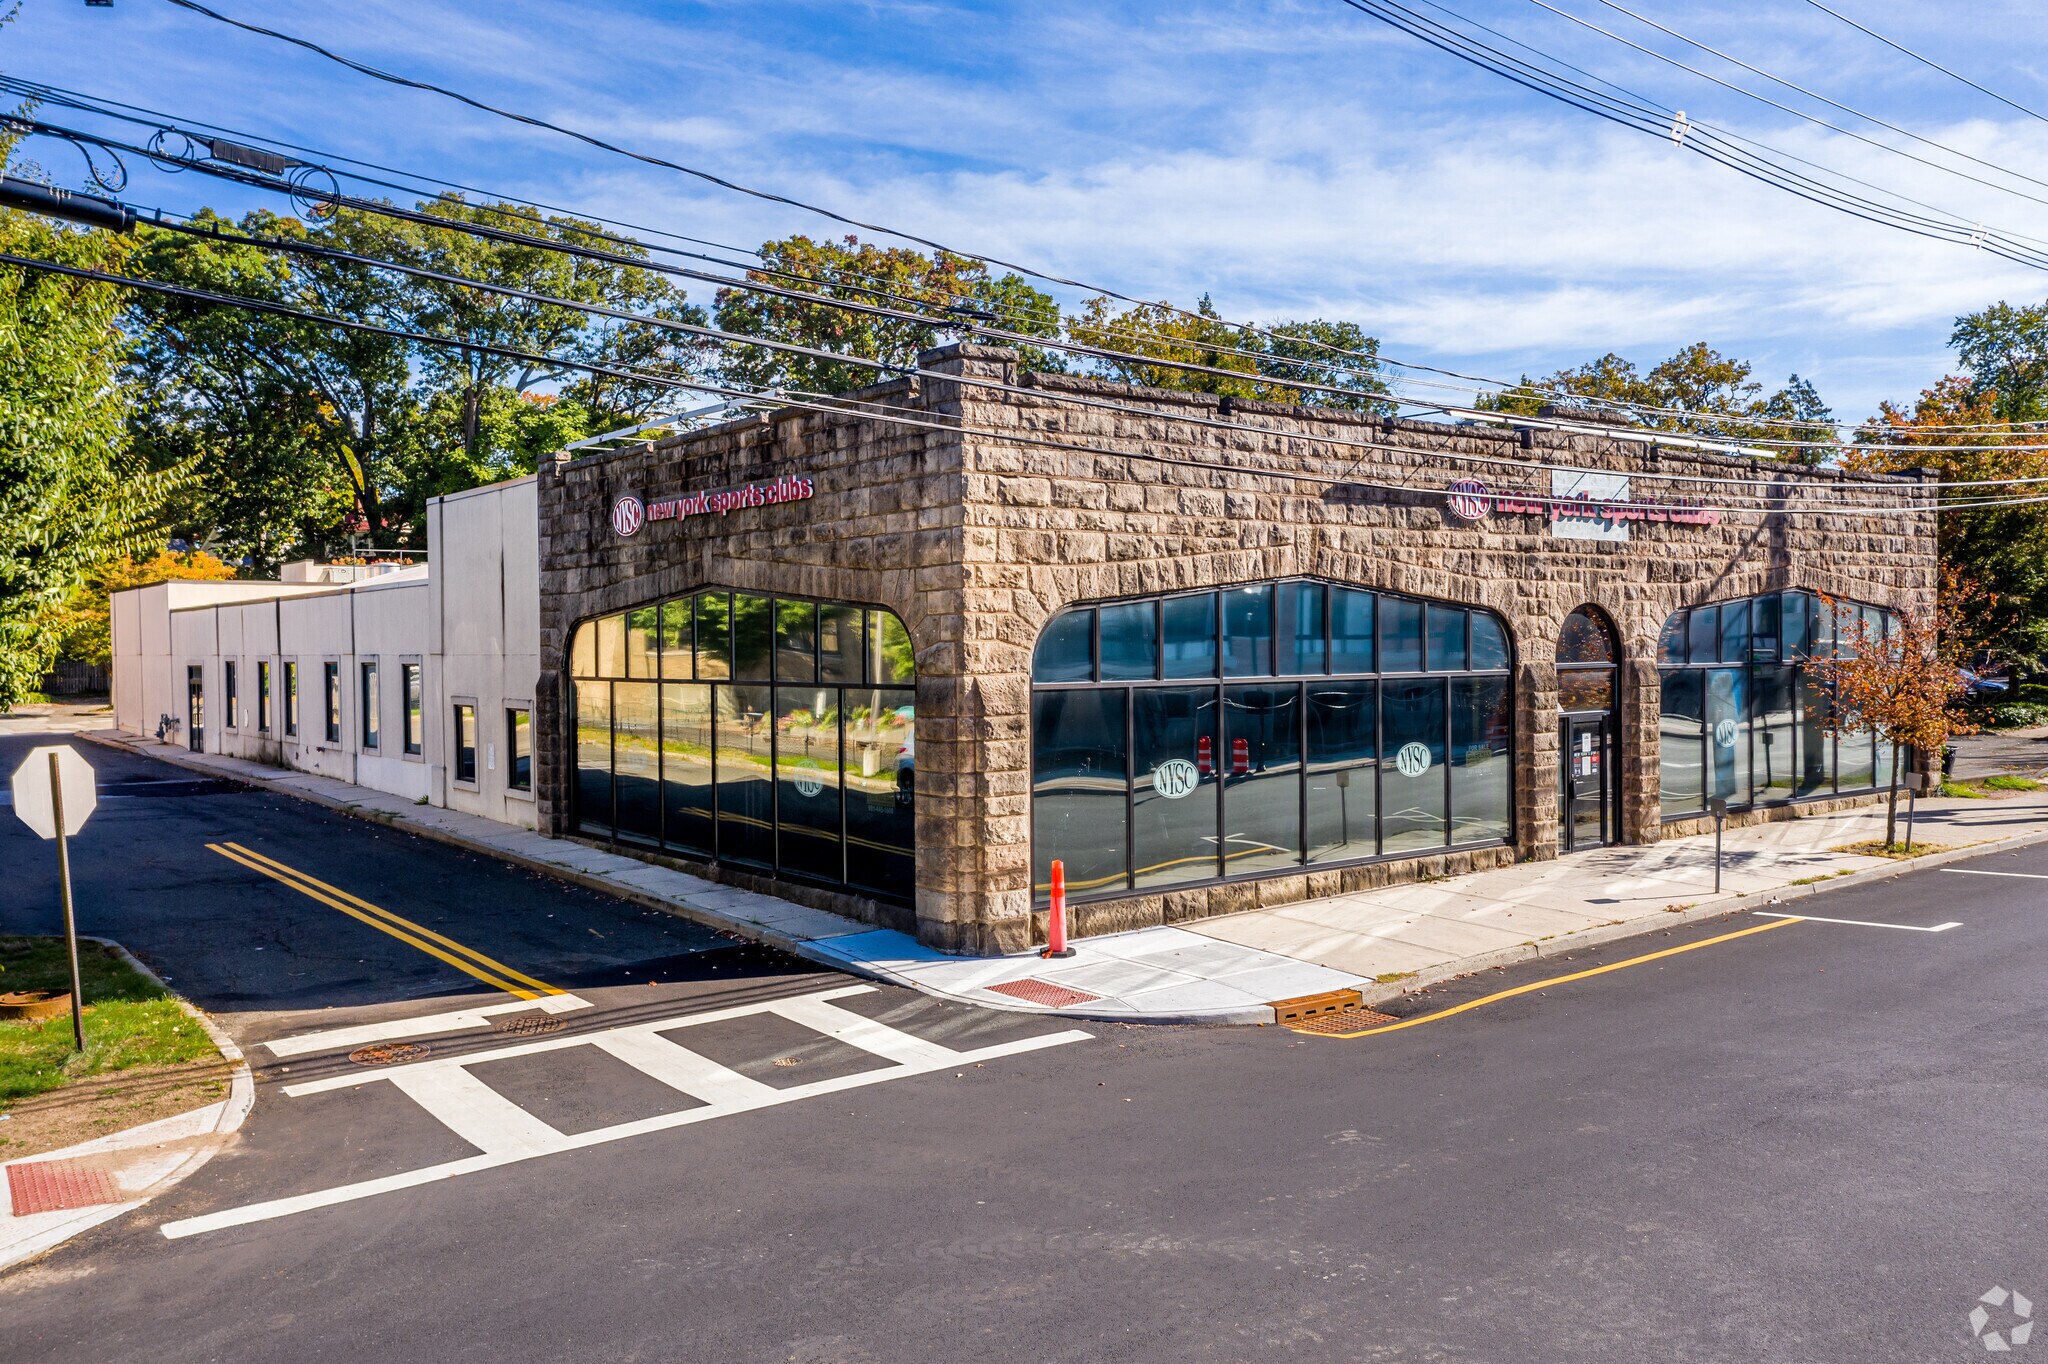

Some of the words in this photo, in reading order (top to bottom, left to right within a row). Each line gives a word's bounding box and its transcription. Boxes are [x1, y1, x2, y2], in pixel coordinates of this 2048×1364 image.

[615, 499, 641, 534] NYSC
[647, 504, 676, 521] new
[676, 491, 710, 522] york
[711, 483, 765, 516] sports
[767, 475, 814, 504] clubs
[1454, 480, 1488, 517] NYSC
[1496, 491, 1547, 514] new
[1549, 490, 1600, 521] york
[1600, 496, 1668, 525] sports
[1669, 497, 1721, 525] clubs
[1159, 762, 1194, 795] NYSC
[1400, 745, 1428, 773] NYSC
